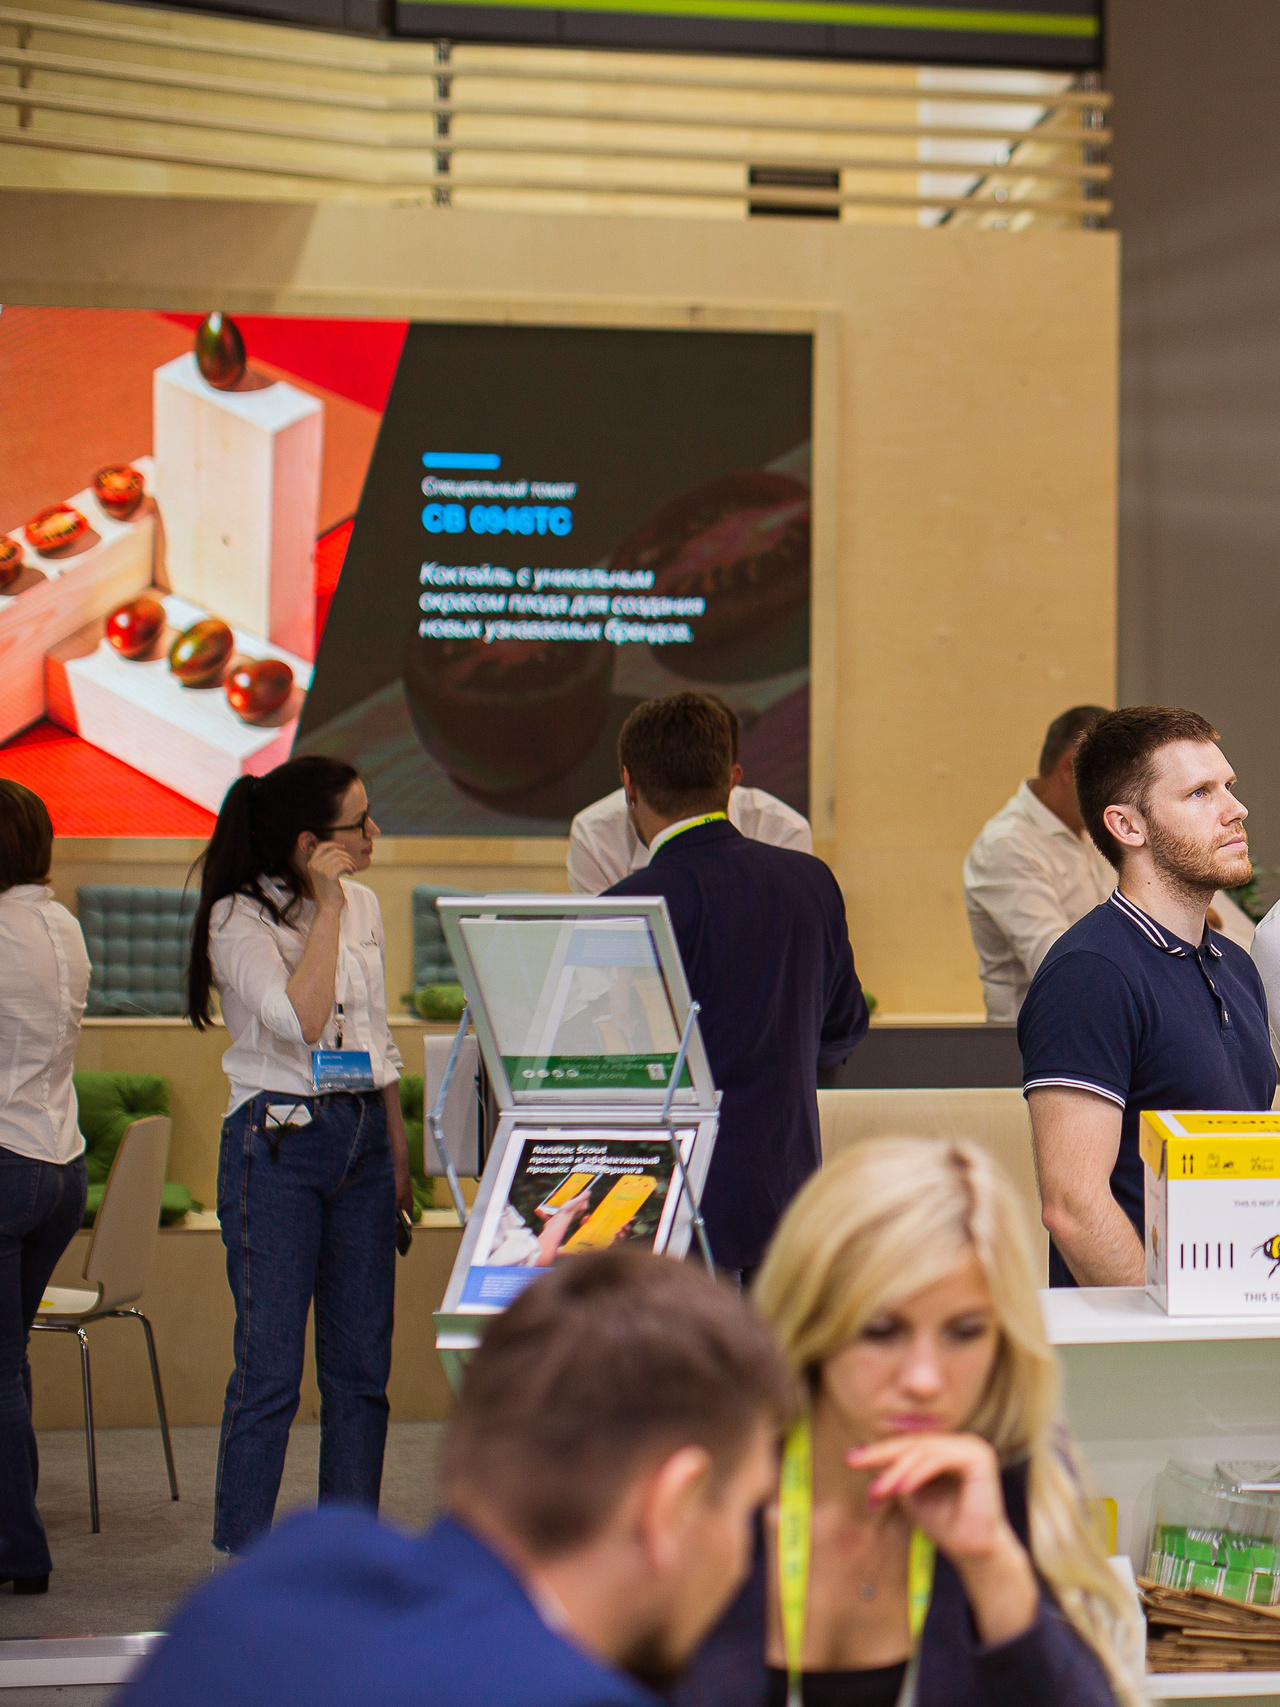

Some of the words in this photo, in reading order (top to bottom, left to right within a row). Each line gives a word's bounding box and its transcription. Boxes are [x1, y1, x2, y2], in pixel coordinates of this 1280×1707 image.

[419, 561, 515, 587] Коктейль
[532, 567, 655, 592] уникальным
[418, 591, 508, 616] окрасом
[508, 594, 570, 617] плода
[610, 596, 706, 618] создания
[418, 618, 483, 639] новых
[576, 1145, 608, 1155] Scout
[529, 1155, 574, 1166] простой
[583, 1155, 660, 1166] эффективный
[526, 1165, 571, 1175] процесс
[1234, 1199, 1249, 1208] THIS
[1259, 1199, 1274, 1208] NOT
[1244, 1292, 1267, 1302] THIS
[1271, 1292, 1280, 1302] IS
